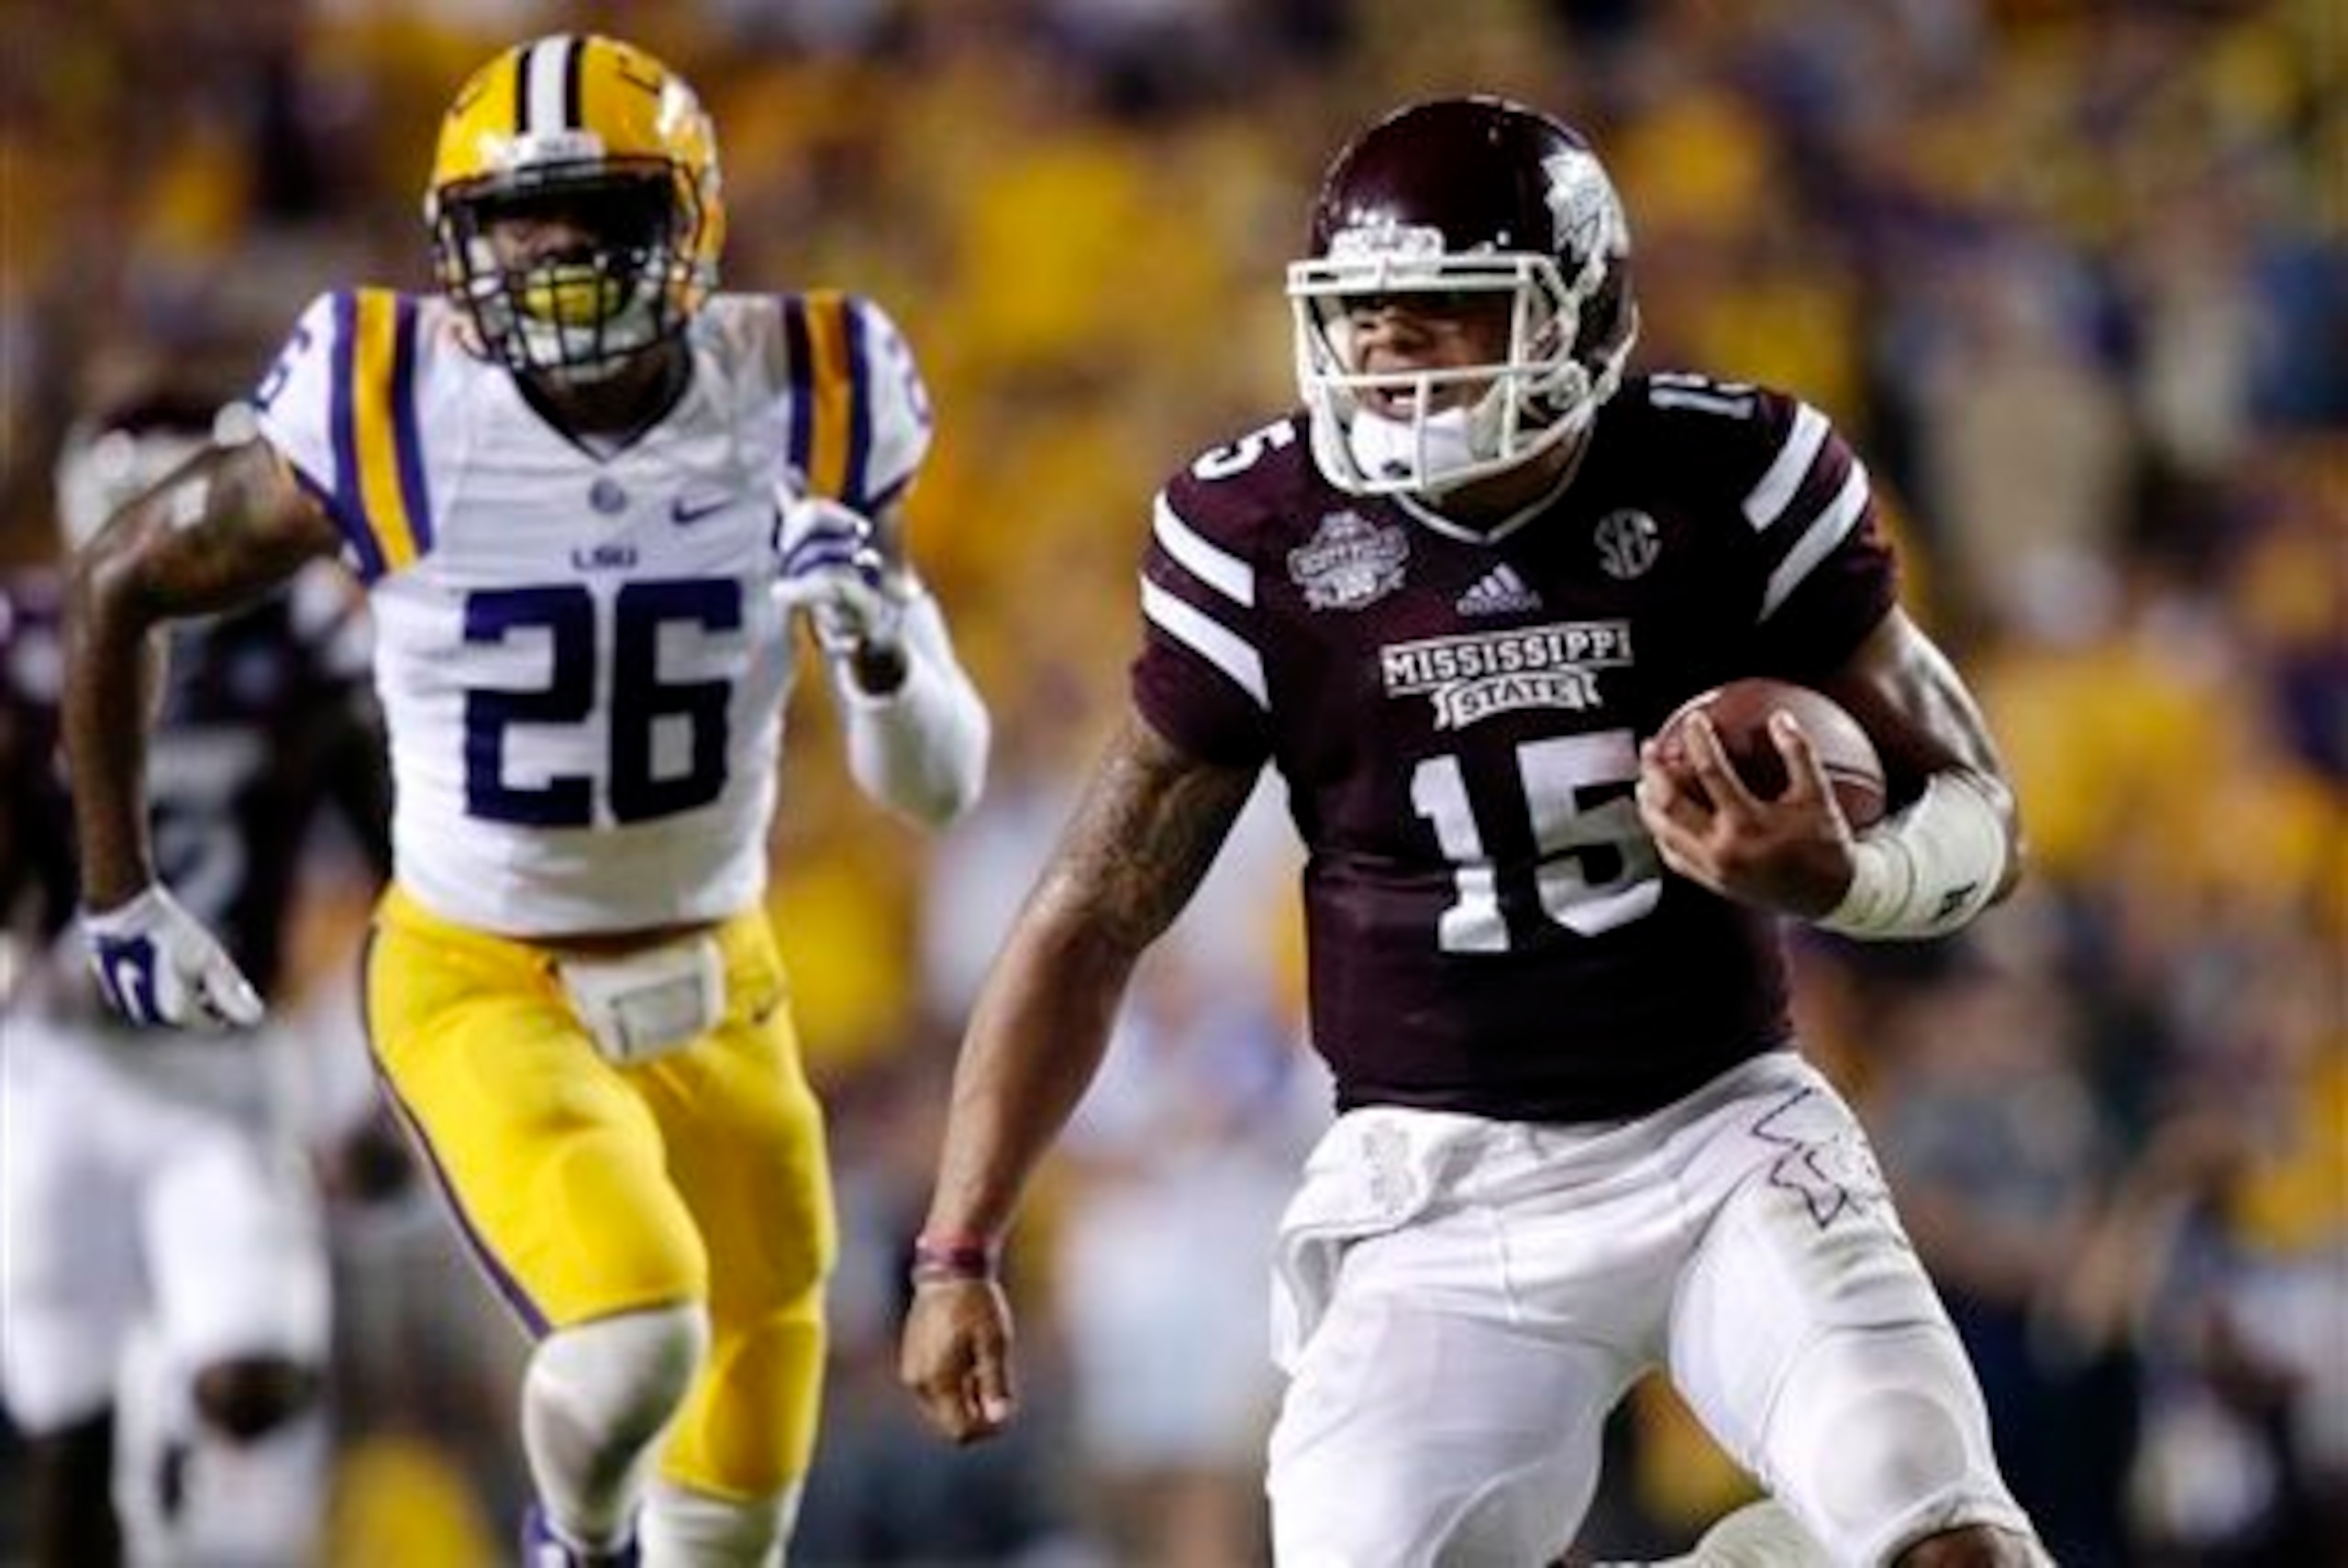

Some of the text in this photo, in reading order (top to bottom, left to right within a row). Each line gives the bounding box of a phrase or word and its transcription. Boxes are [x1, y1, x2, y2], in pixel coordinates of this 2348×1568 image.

[570, 546, 639, 571] LSU
[1594, 508, 1662, 580] SEC
[1382, 629, 1634, 686] MISSISSIPPI
[462, 578, 741, 827] 26
[1459, 677, 1571, 715] STATE
[1410, 730, 1663, 954] 15
